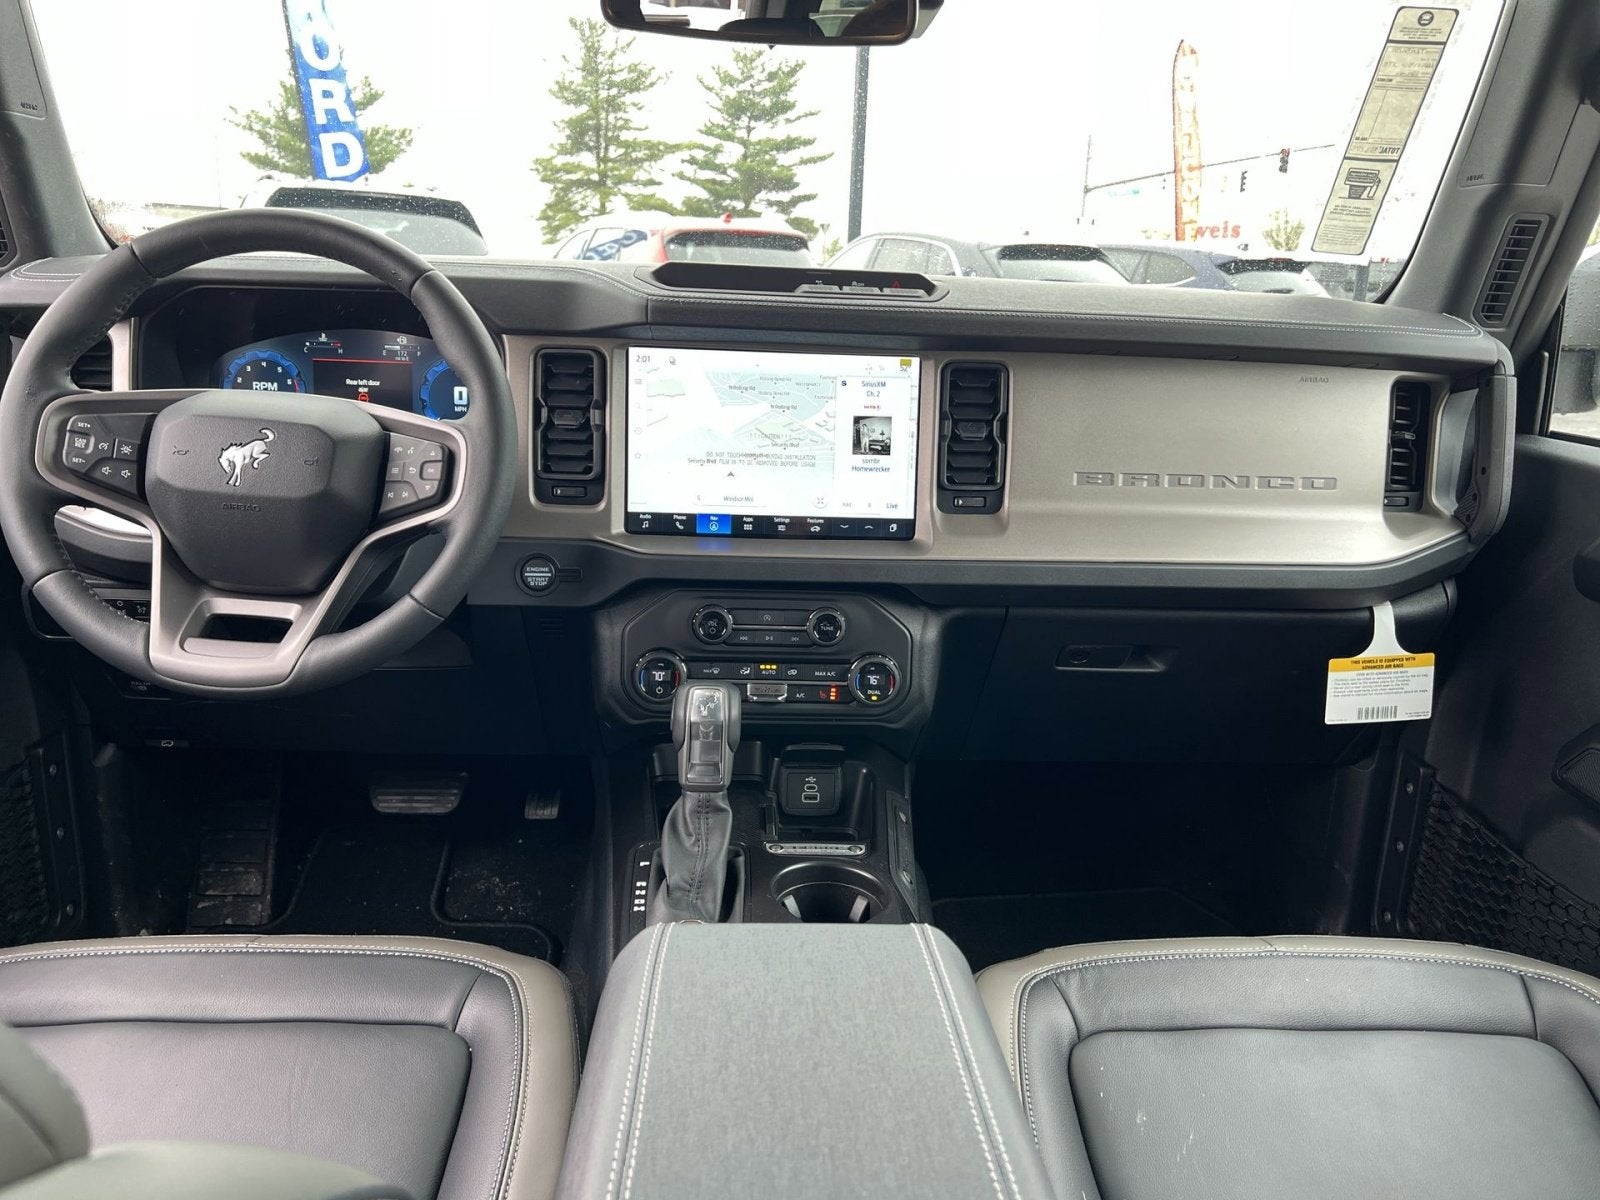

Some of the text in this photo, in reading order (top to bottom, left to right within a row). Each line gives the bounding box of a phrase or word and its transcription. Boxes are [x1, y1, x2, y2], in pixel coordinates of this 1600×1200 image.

[298, 0, 365, 179] ORD
[252, 381, 278, 391] RPM
[345, 378, 358, 386] Rear
[861, 380, 887, 388] SiriusXM
[851, 465, 890, 473] Homewrecker
[1073, 471, 1338, 491] BRONCO
[222, 502, 262, 513] AIRBAG
